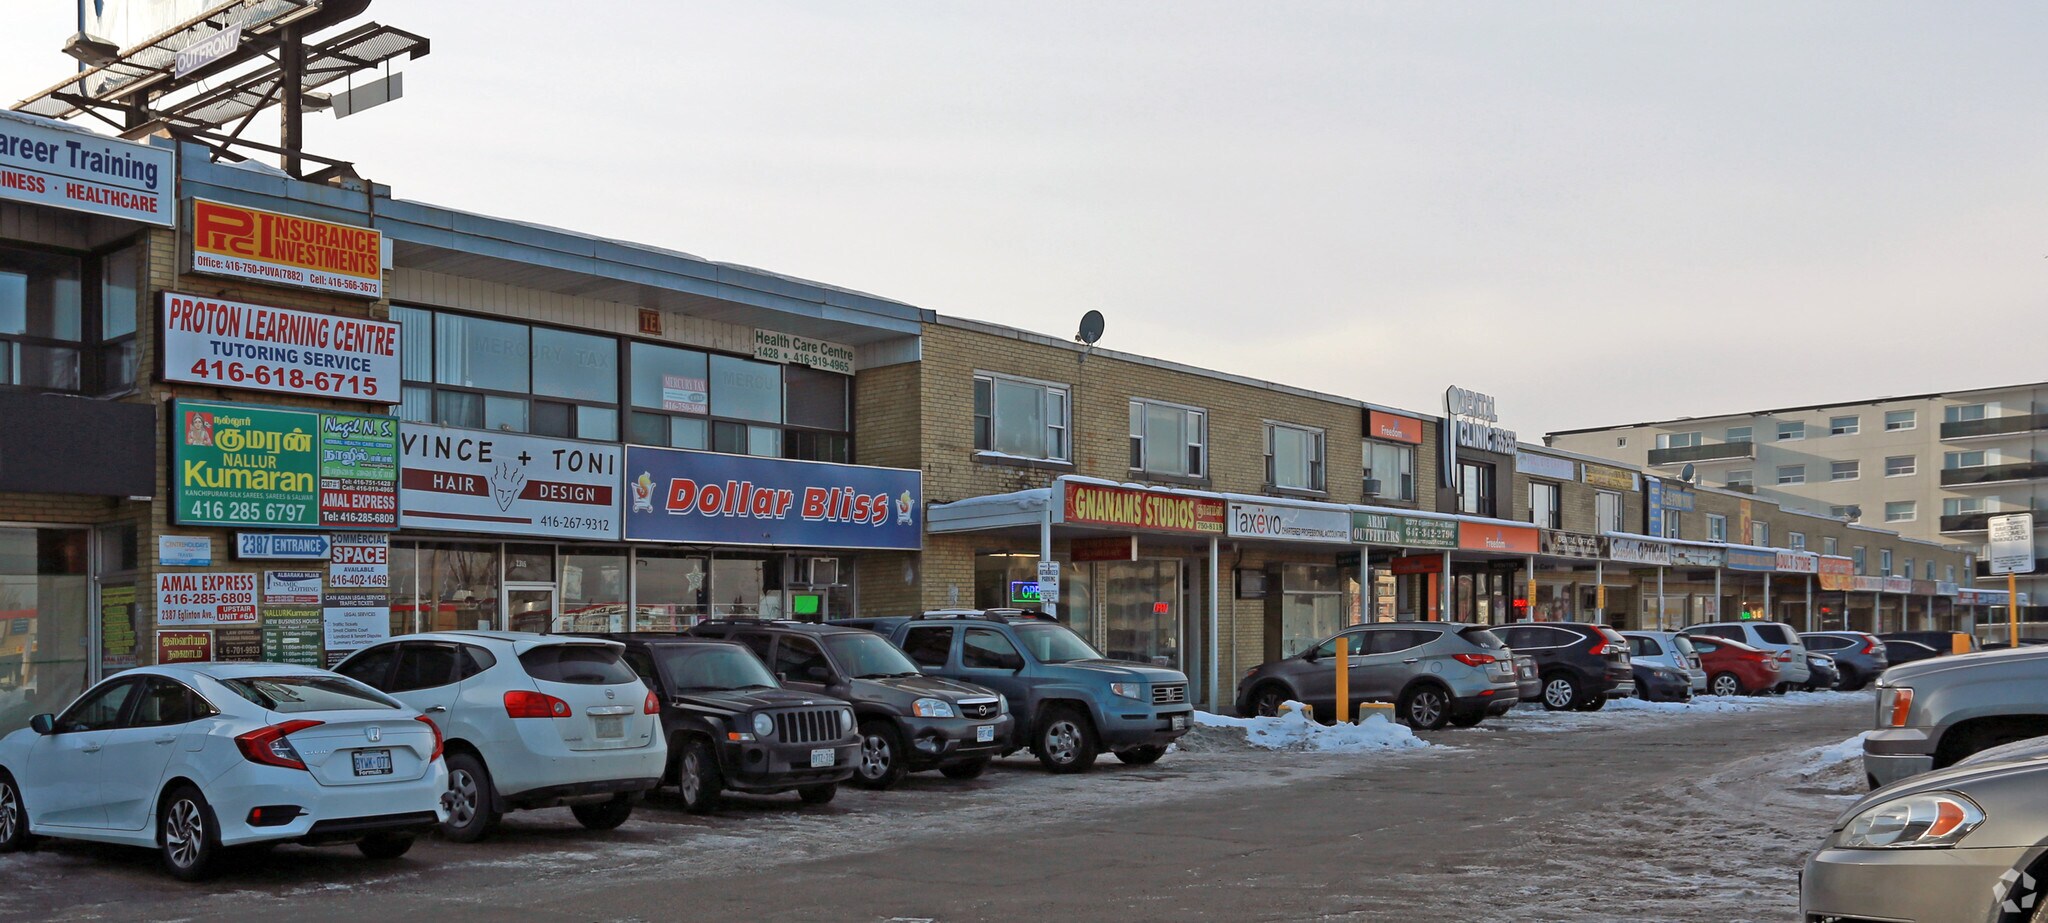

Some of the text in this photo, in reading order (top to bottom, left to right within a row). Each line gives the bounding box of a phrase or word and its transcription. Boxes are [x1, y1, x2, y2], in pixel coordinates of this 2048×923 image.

[177, 29, 237, 72] OUTFRONT
[66, 140, 158, 190] Training
[0, 171, 158, 213] INESS HEALTHCARE
[197, 255, 378, 294] Office: 416-750-PUVA(7882) Cell: 416-566-3673
[169, 298, 396, 357] PROTON LEARNING CENTRE
[755, 330, 854, 361] Health Care Centre
[210, 340, 371, 373] TUTORING SERVICE
[576, 351, 610, 369] TAX
[793, 353, 850, 372] 416-919-4965
[190, 358, 378, 396] 416-618-6715
[1458, 388, 1498, 422] DENTAL
[1381, 424, 1403, 438] Freedom
[1460, 420, 1493, 451] CLINIC
[223, 453, 277, 468] NALLUR
[401, 433, 493, 463] VINCE
[552, 449, 614, 475] TONI
[184, 460, 314, 492] Kumaran
[230, 491, 241, 499] SILK
[432, 474, 596, 502] HAIR DESIGN
[322, 493, 395, 510] AMAL EXPRESS
[664, 477, 889, 527] Dollar Bliss
[1075, 487, 1195, 530] GNANAMS STUDIOS
[192, 501, 306, 522] 416 285 6797
[323, 511, 395, 524] Tel: 416-285-6809
[1232, 506, 1281, 534] Taxëvo
[540, 516, 609, 532] 416-267-9312
[1366, 515, 1388, 529] ARMY
[242, 535, 321, 554] 2387 ENTRANCE
[331, 534, 387, 544] COMMERCIAL
[1354, 528, 1400, 543] OUTFITTERS
[1486, 536, 1506, 548] Freedom
[332, 547, 386, 564] SPACE
[1638, 541, 1668, 561] OPTICAL
[1794, 556, 1811, 571] STORE
[161, 575, 254, 592] AMAL EXPRESS
[331, 574, 387, 586] 416-402-1469
[163, 593, 252, 605] 416-285-6809
[1022, 585, 1041, 599] OPE
[161, 609, 176, 620] 2387
[178, 609, 201, 622] Eglinton
[219, 646, 260, 655] 46-701-9933
